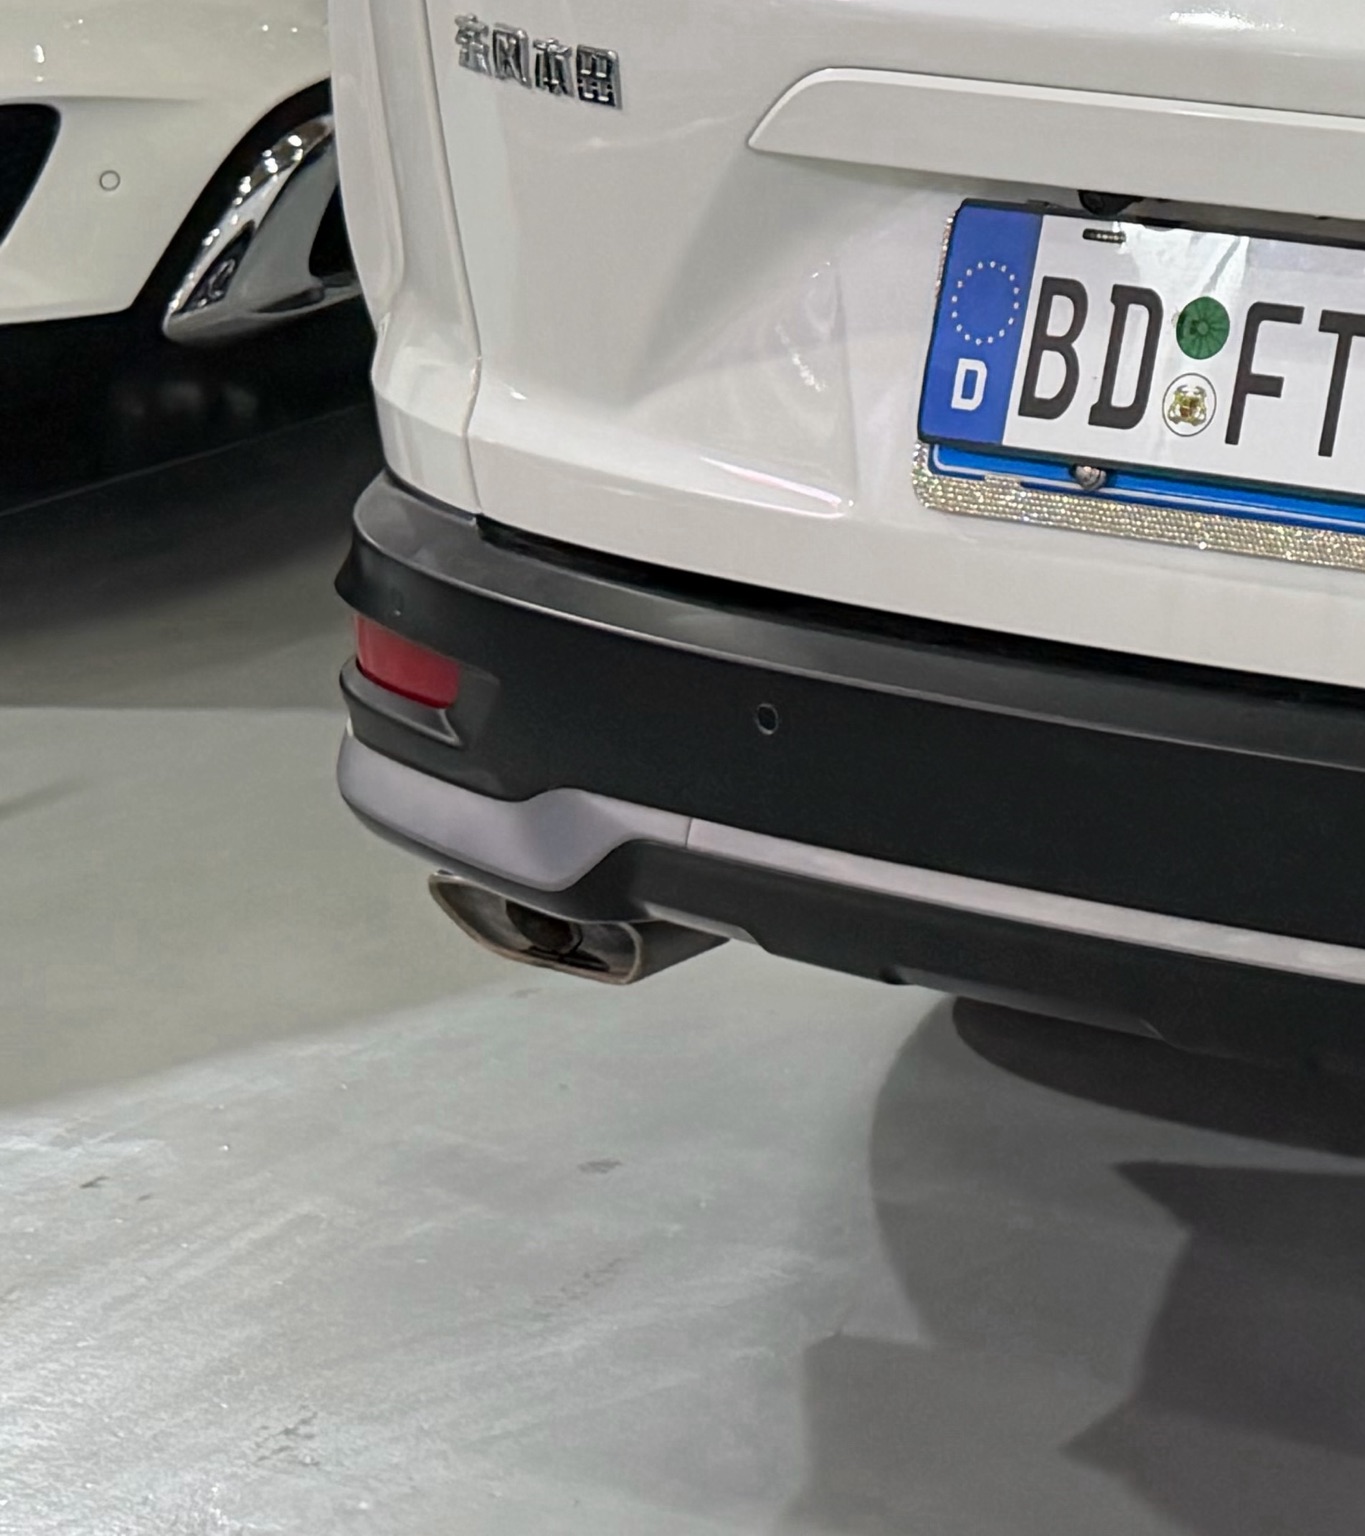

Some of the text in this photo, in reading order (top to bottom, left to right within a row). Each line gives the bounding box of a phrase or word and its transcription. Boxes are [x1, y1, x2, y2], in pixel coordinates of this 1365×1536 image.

[454, 13, 623, 111] 东风本田
[949, 357, 989, 412] D
[1017, 274, 1165, 431] BD
